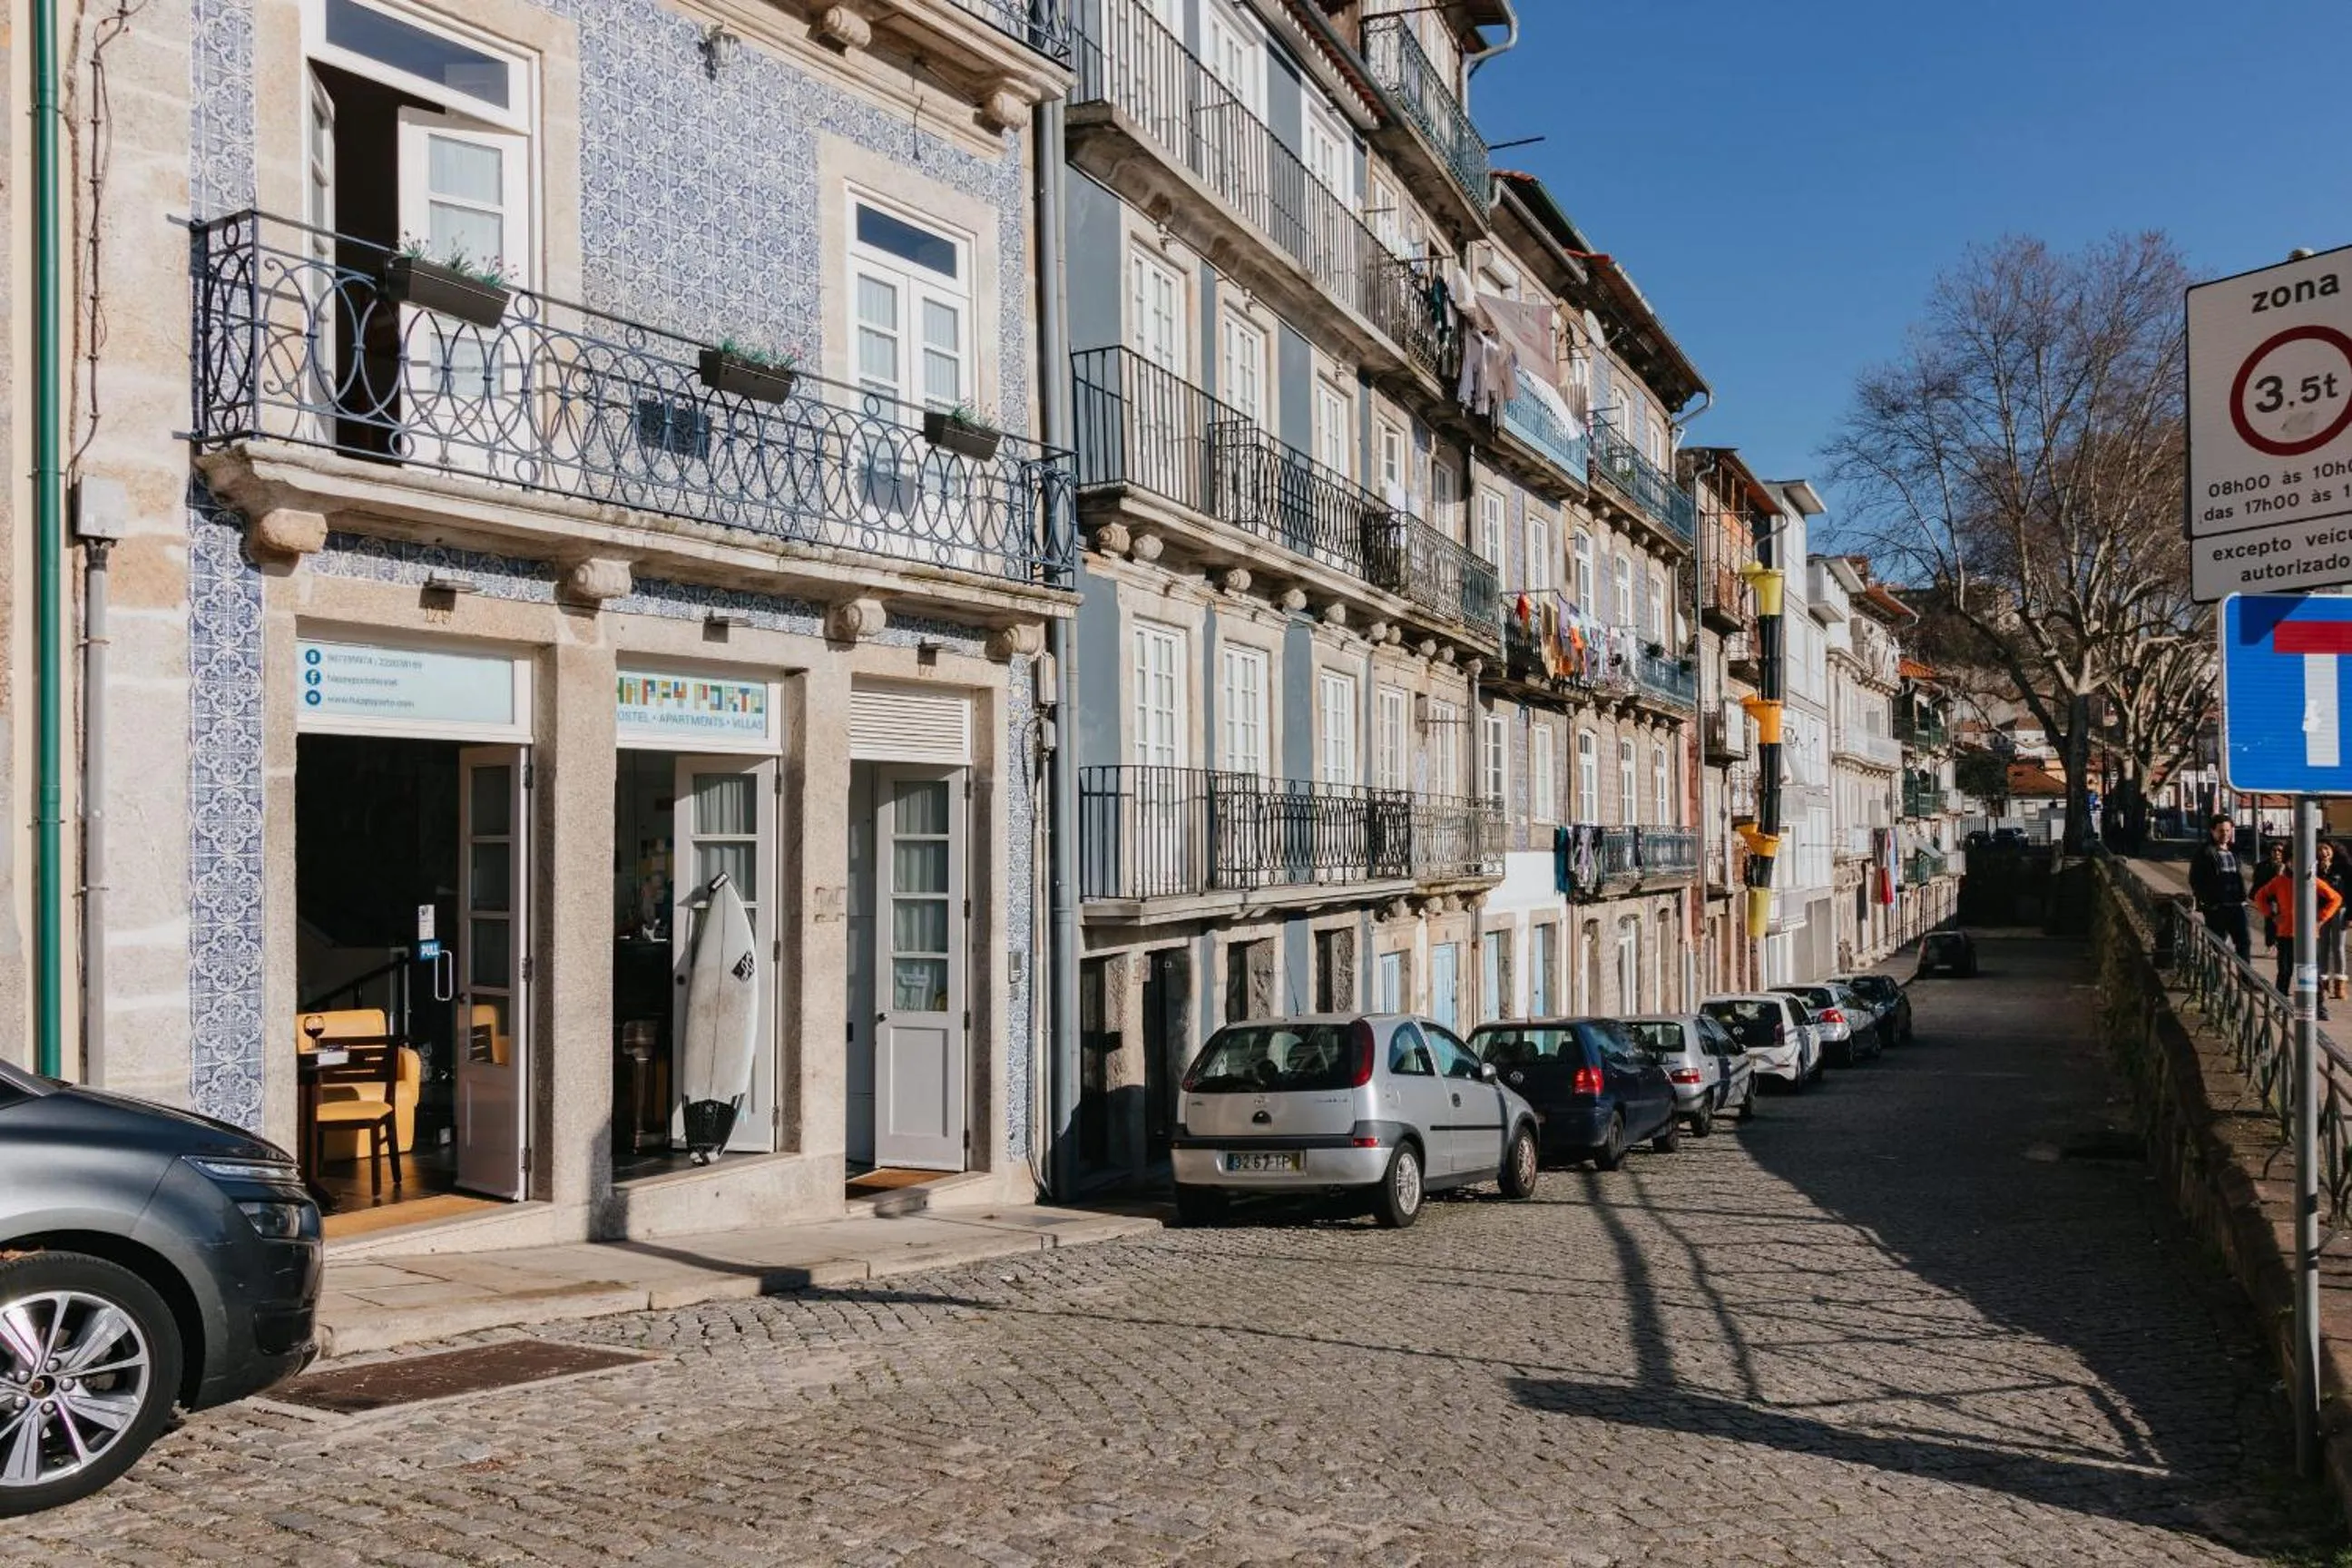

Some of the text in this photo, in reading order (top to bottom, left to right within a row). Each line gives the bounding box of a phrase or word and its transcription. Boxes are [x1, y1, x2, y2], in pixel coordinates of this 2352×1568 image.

[2251, 273, 2341, 314] zona
[2255, 373, 2338, 413] 3.5t
[2209, 475, 2270, 498] 08h00
[2282, 471, 2302, 485] às
[2203, 506, 2233, 521] das
[2244, 493, 2299, 514] 17h00
[2311, 488, 2332, 504] às
[2212, 527, 2352, 561] excepto veíc
[2241, 554, 2350, 582] autorizado
[694, 682, 764, 714] PORTO
[617, 711, 763, 730] OSTEL APARTMENTS VILLAS
